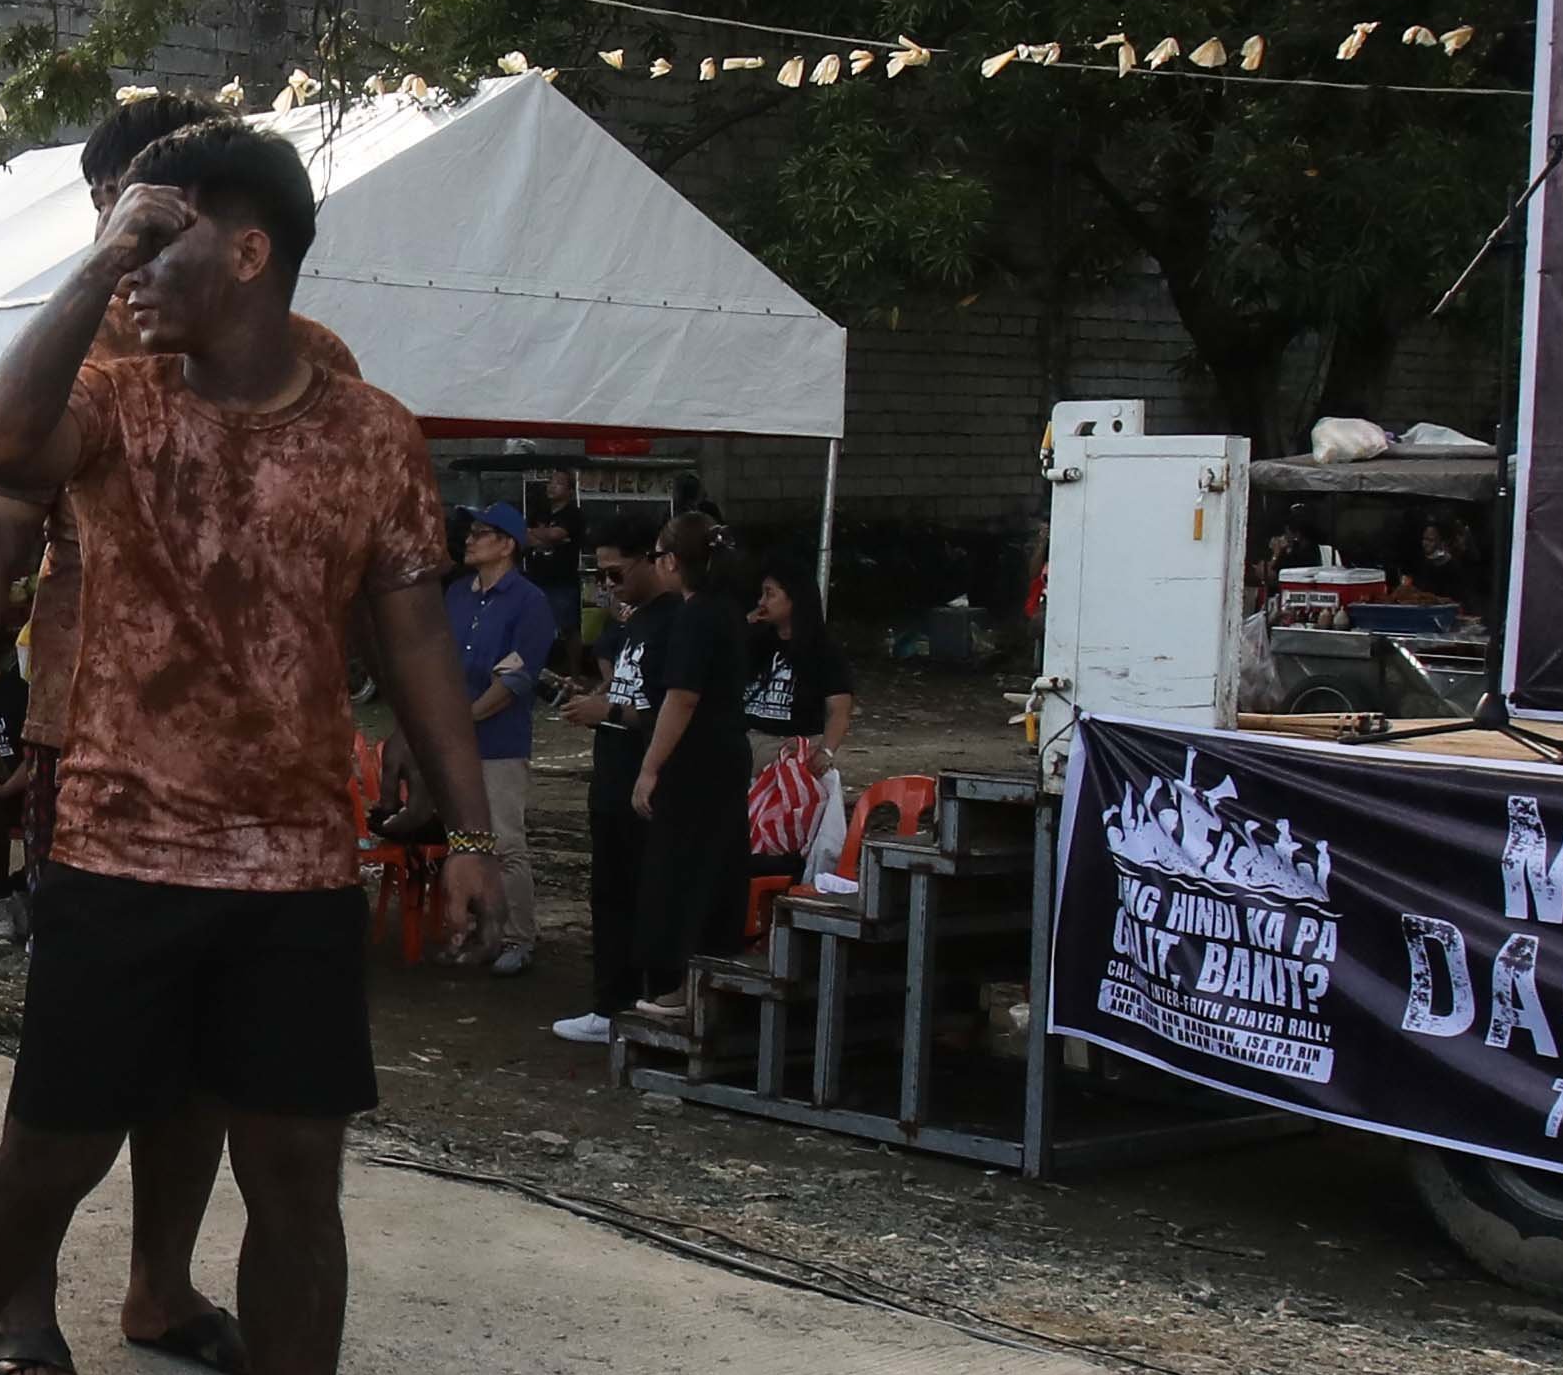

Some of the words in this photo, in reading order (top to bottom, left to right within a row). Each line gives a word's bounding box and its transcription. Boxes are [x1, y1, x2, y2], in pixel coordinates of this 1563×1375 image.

[1165, 890, 1241, 942] HINDI
[1245, 906, 1287, 953] KA
[1292, 916, 1338, 963] PA
[1195, 941, 1330, 1014] BAKIT?
[1224, 1006, 1286, 1035] PRAYER
[1245, 1034, 1271, 1052] ISA
[1275, 1041, 1293, 1057] PA
[1299, 1046, 1321, 1062] RIN
